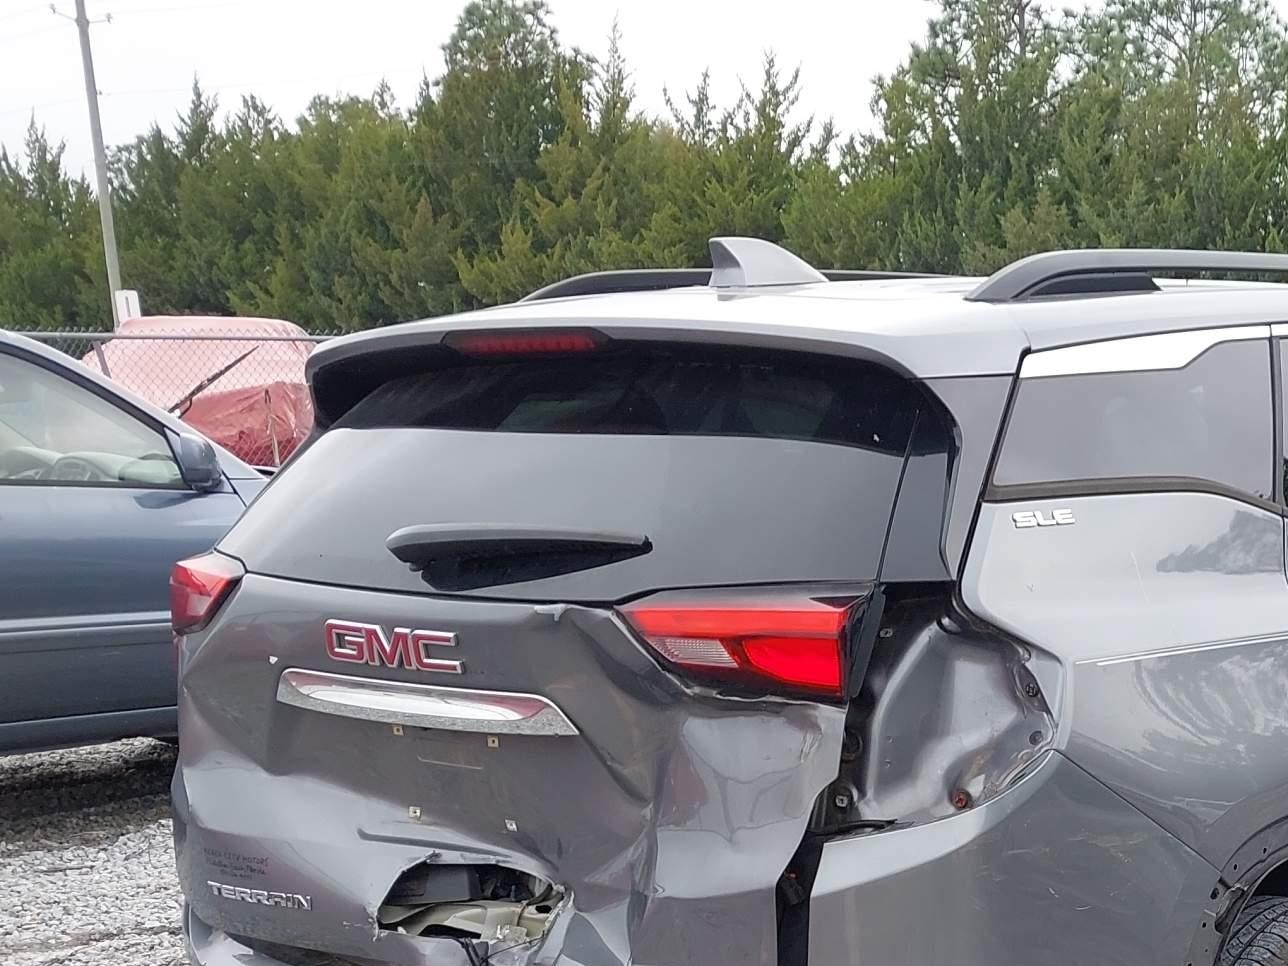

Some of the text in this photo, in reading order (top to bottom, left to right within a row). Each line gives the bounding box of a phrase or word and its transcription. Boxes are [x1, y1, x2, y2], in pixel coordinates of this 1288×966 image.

[1012, 508, 1076, 529] SLE
[324, 618, 466, 675] GMC
[207, 881, 313, 910] TERRAIN
